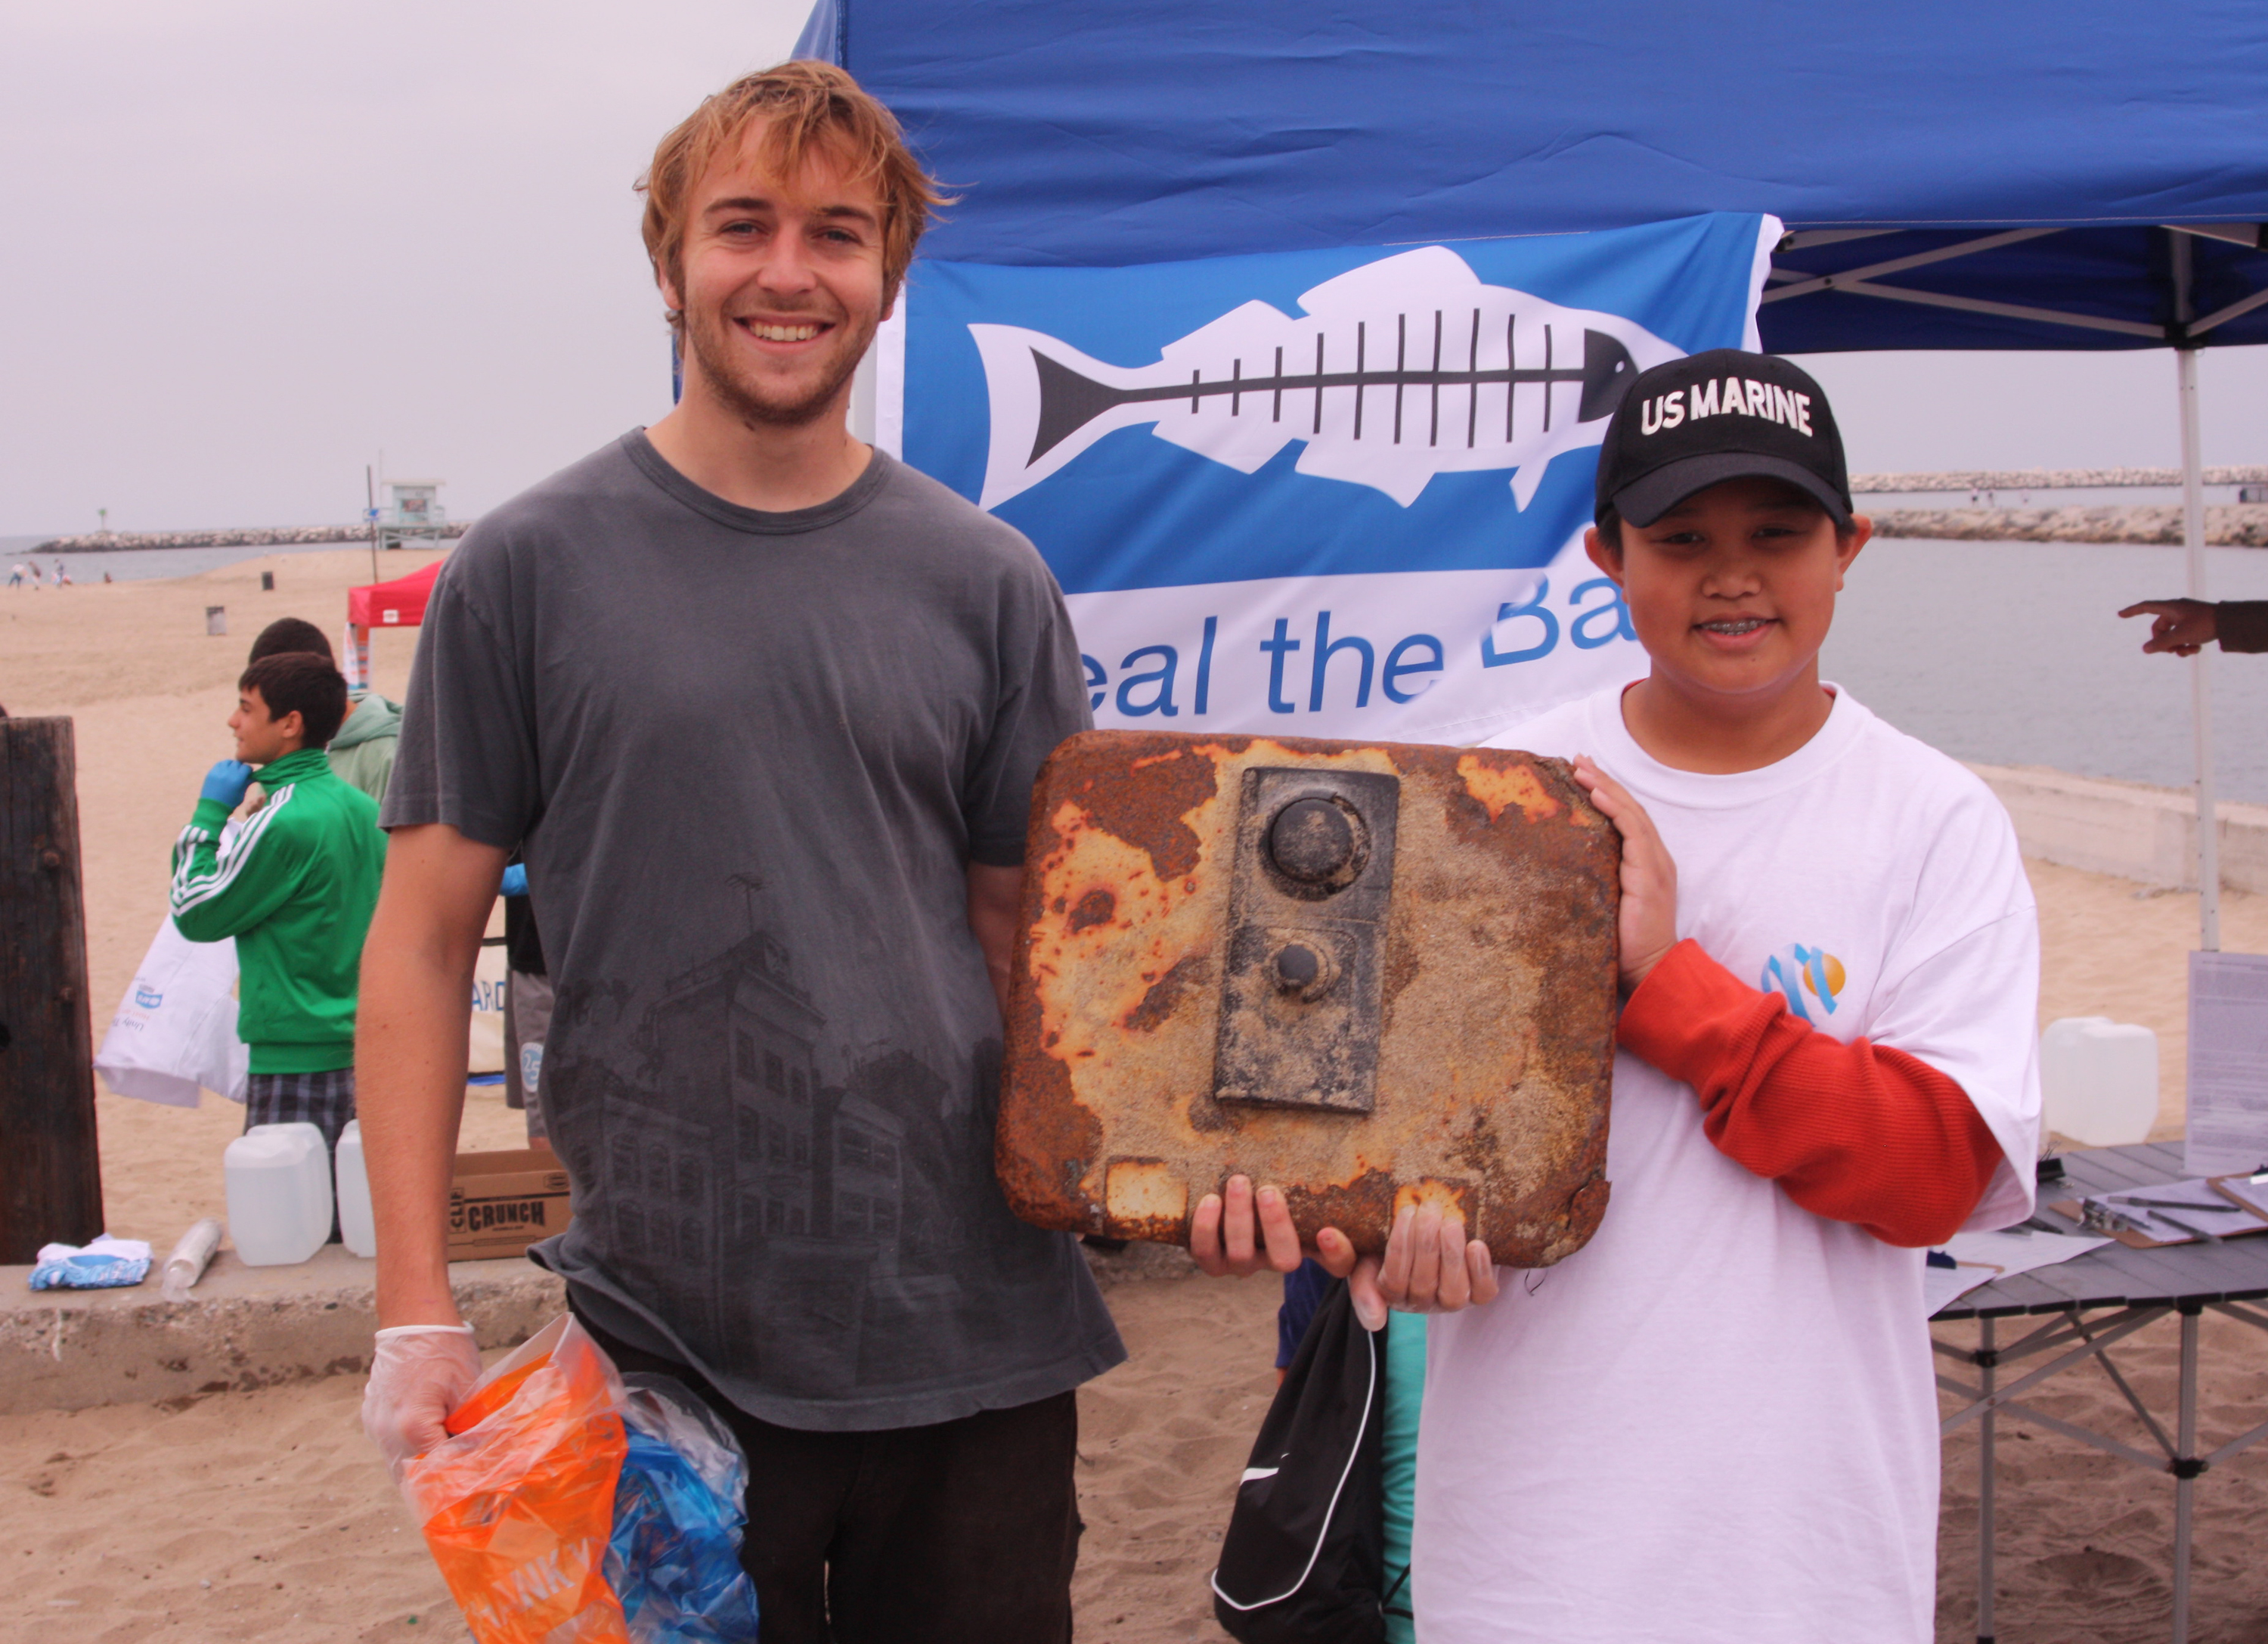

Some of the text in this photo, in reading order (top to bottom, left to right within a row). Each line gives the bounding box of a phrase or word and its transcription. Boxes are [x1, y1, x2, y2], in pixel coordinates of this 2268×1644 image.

[1641, 377, 1813, 438] US MARINE
[1259, 610, 1445, 714] the
[468, 1201, 546, 1232] CRUNCH
